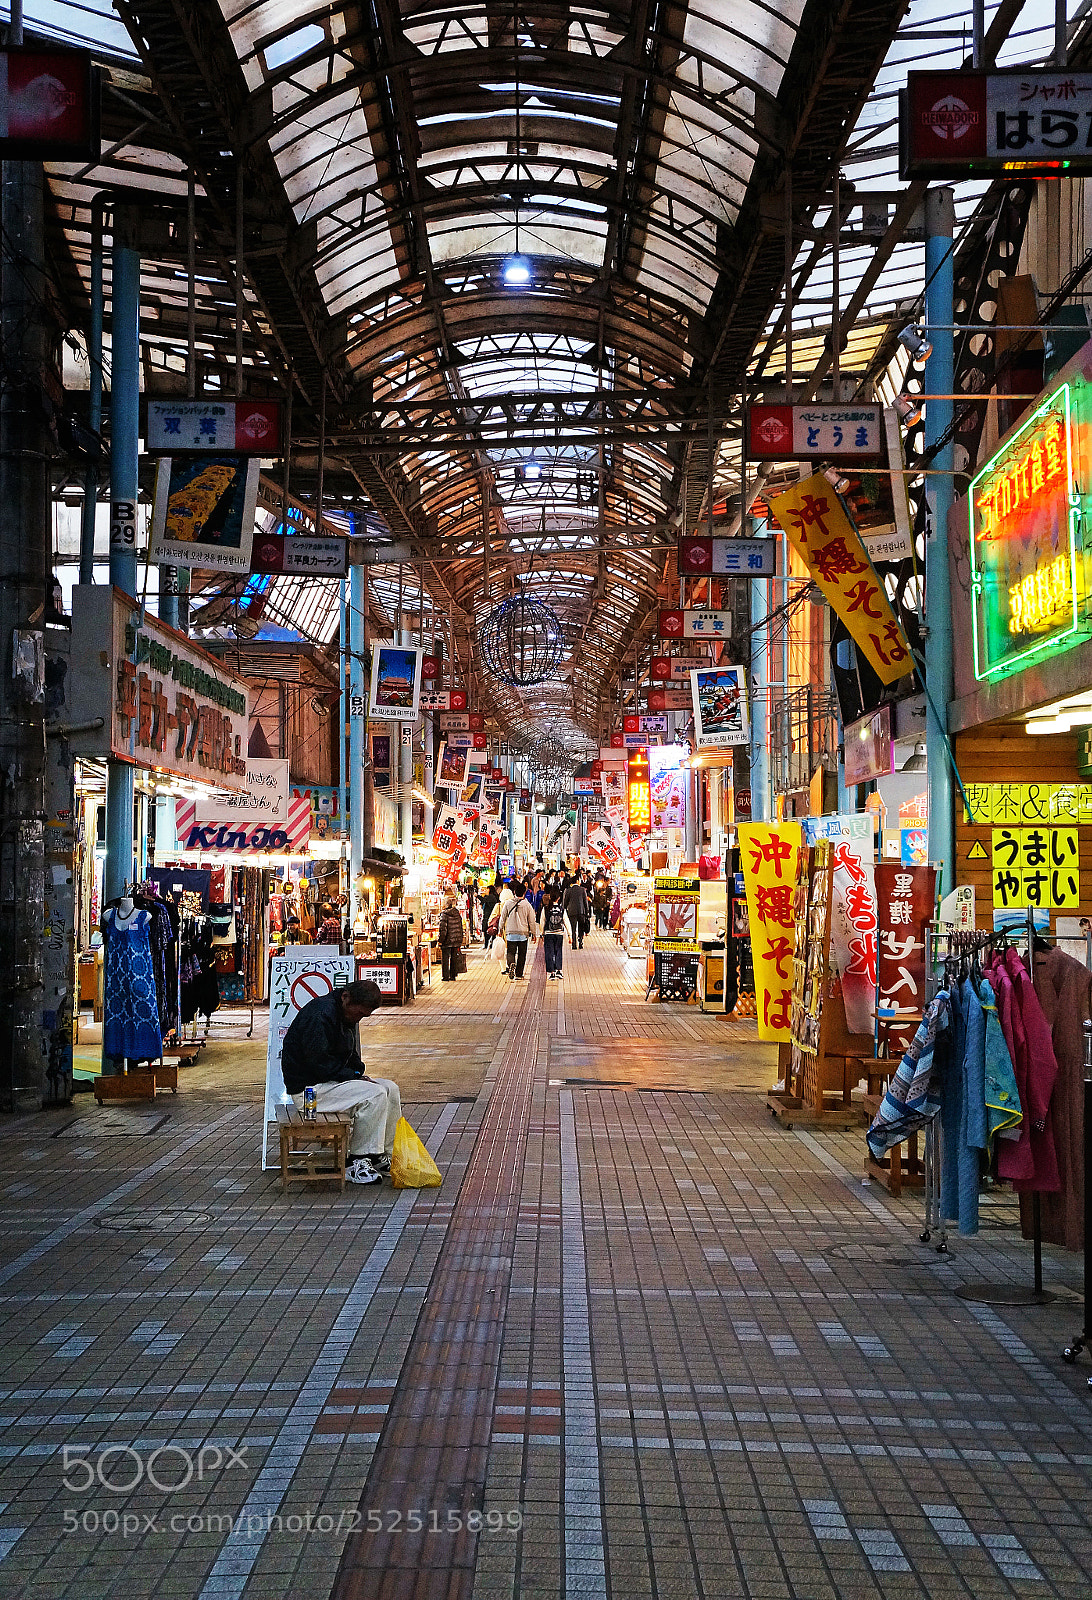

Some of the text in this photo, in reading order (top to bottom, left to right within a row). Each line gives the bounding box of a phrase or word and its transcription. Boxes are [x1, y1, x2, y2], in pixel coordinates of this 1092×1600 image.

[922, 112, 978, 125] HEIWADORI
[996, 109, 1092, 149] はら
[163, 417, 217, 435] 双葉
[806, 426, 869, 447] とうま
[112, 502, 135, 521] B
[111, 525, 135, 544] 29
[294, 554, 341, 566] 平良カーテン
[725, 553, 763, 569] 三和
[165, 565, 178, 577] B
[786, 494, 908, 665] 沖縄そば
[351, 696, 363, 706] B
[351, 707, 364, 716] 22
[402, 727, 412, 736] B
[402, 737, 411, 745] 21
[424, 761, 433, 769] 20
[905, 819, 927, 828] PHOT
[994, 830, 1078, 867] うまい
[994, 869, 1078, 907] やすい
[275, 960, 351, 975] おりて下さい
[273, 972, 292, 1018] バイク
